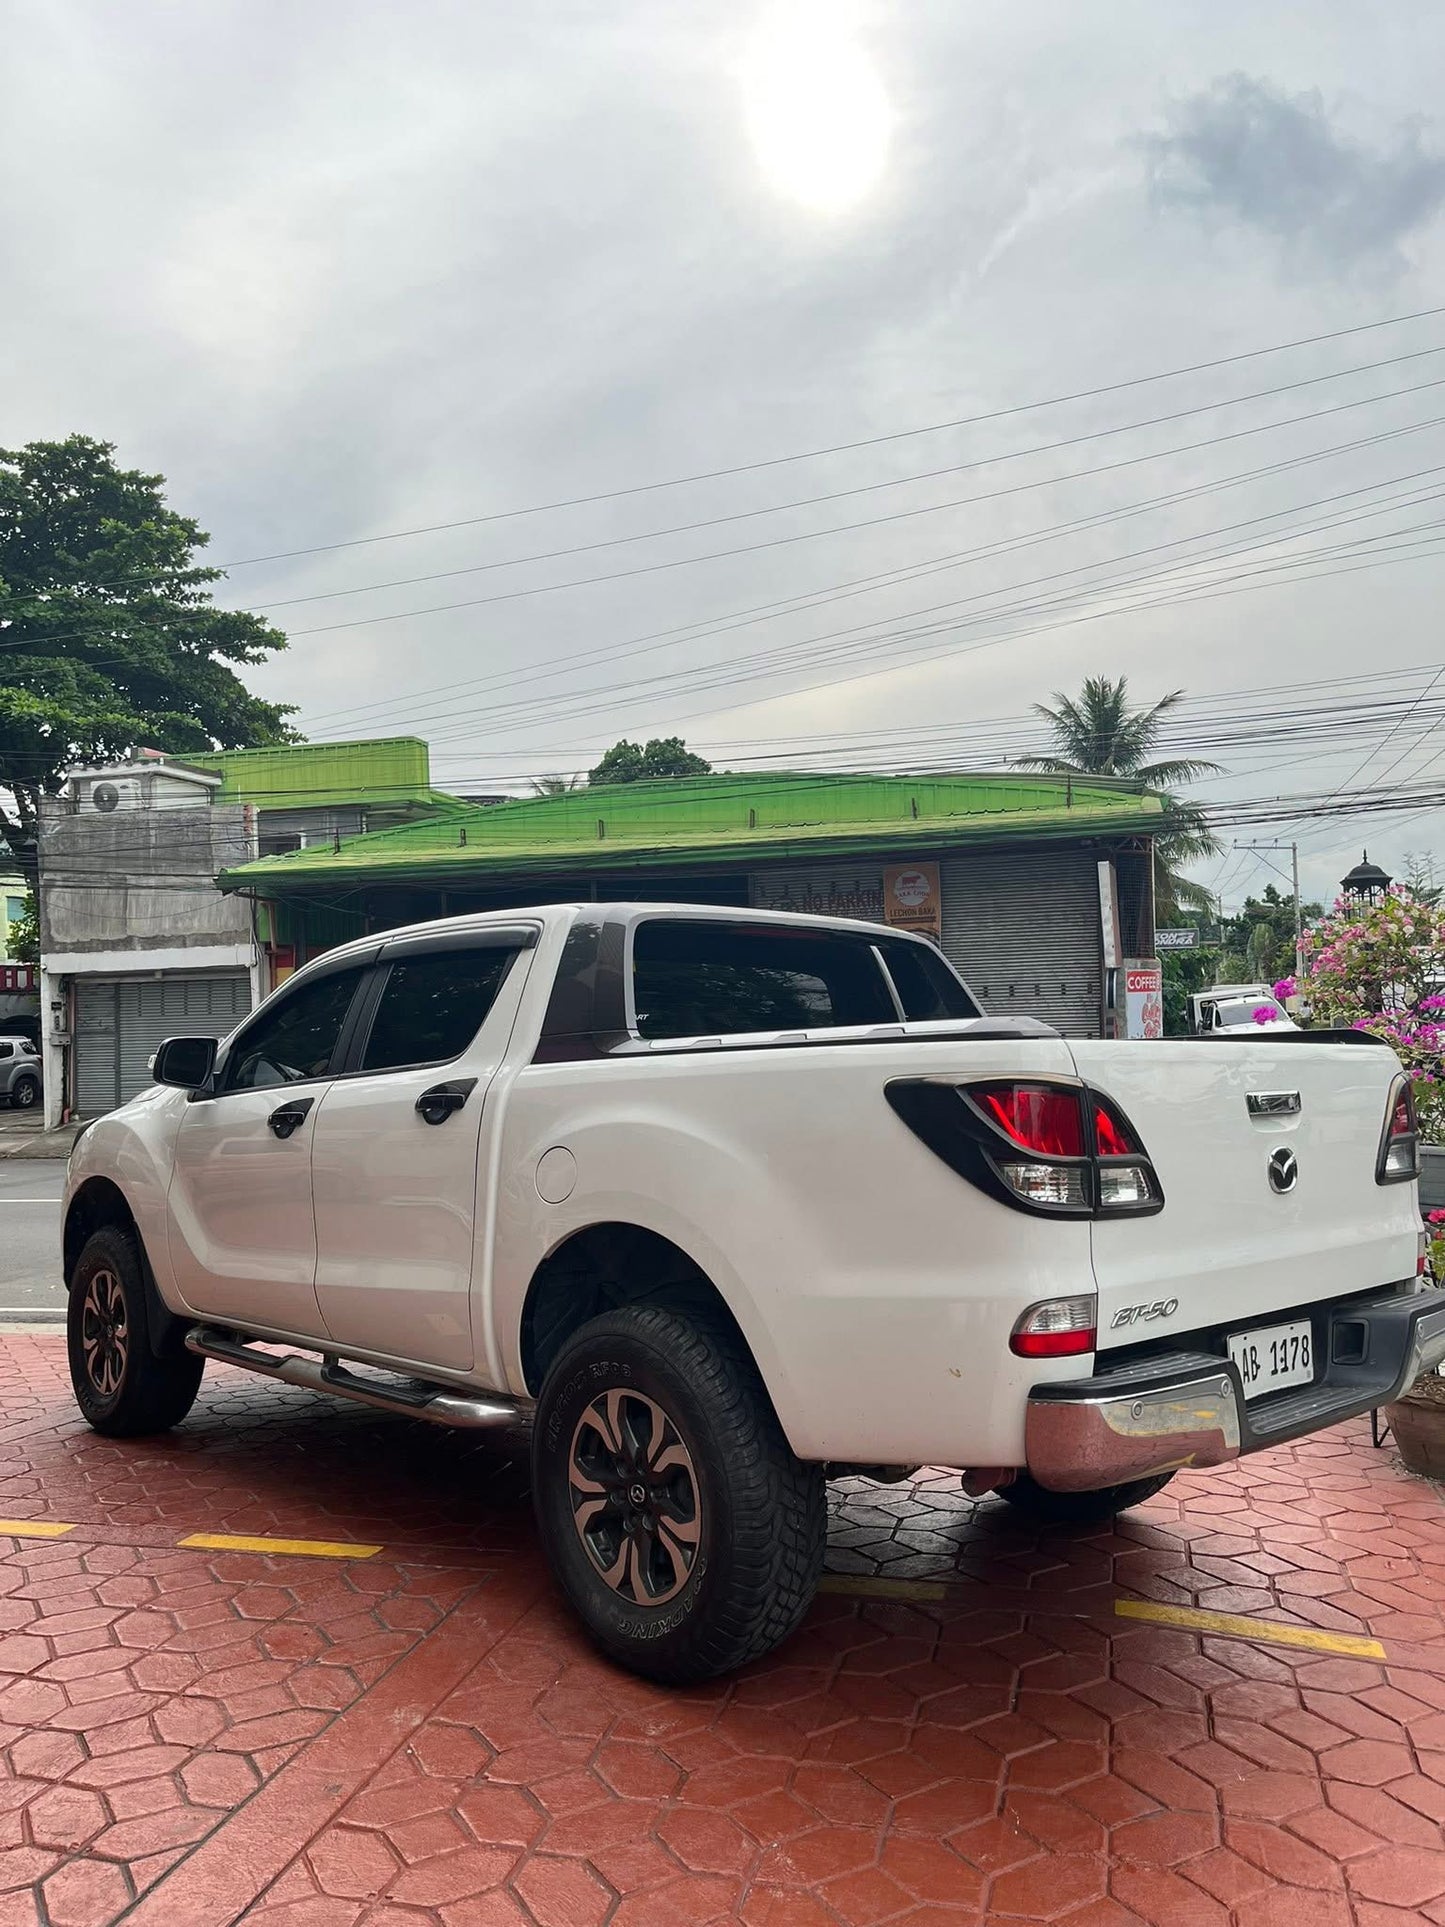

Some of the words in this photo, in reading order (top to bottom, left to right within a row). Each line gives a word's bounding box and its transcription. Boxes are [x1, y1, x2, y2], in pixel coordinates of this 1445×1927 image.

[889, 908, 917, 918] LECHON
[1128, 976, 1156, 990] COFFEE
[1110, 1297, 1178, 1329] BT-50
[1232, 1345, 1260, 1385] AB
[1269, 1334, 1310, 1376] 1178
